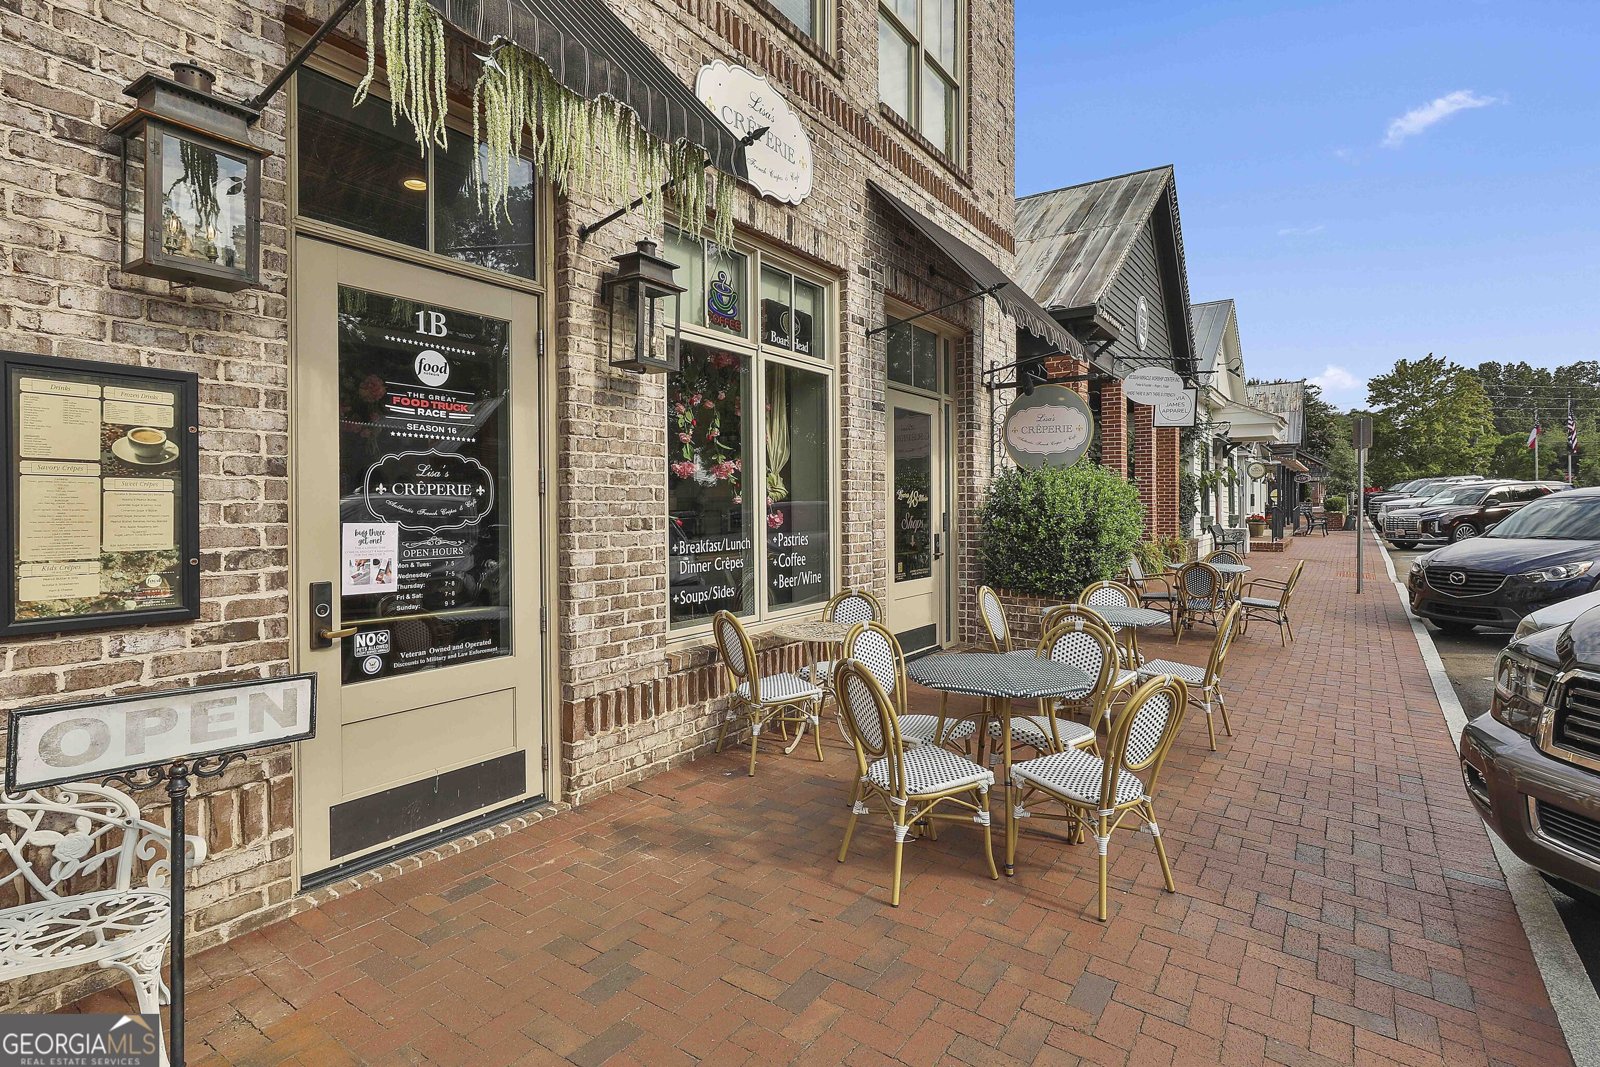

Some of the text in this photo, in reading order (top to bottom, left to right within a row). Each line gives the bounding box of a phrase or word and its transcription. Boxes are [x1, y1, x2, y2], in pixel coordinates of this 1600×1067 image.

[748, 91, 775, 123] Lisa's
[721, 105, 795, 165] CRÊERIE
[415, 310, 448, 338] 1B
[417, 357, 448, 376] food
[50, 383, 72, 392] Drinks
[120, 391, 140, 399] Frozen
[407, 391, 456, 403] THE GREAT
[392, 396, 470, 412] FOOD TRUCK
[417, 408, 447, 418] RACE
[1036, 413, 1056, 422] Lisa's
[406, 423, 445, 433] SEASON
[1021, 424, 1073, 434] CRÊPERIE
[37, 464, 84, 473] Savory Crêpes
[416, 464, 449, 478] Lisa's
[391, 481, 472, 496] CRÊPERIE
[417, 508, 438, 516] French
[354, 528, 386, 538] buy three
[778, 533, 809, 547] Pastries
[358, 535, 382, 546] get one!
[679, 538, 750, 555] Breakfast/Lunch
[403, 549, 429, 558] OPEN
[432, 547, 464, 556] HOURS
[680, 556, 744, 575] Dinner Crêpes
[778, 553, 806, 568] Coffee
[397, 571, 431, 579] Wednesday:
[778, 570, 822, 589] Beer/Wine
[397, 582, 426, 590] Thursday:
[680, 585, 735, 605] Soups/Sides
[356, 633, 376, 648] NO
[400, 639, 492, 659] Veteran Owned and Operated
[393, 660, 419, 669] Discounts
[426, 655, 447, 663] Military
[468, 646, 498, 656] Enforcement
[38, 687, 298, 768] OPEN
